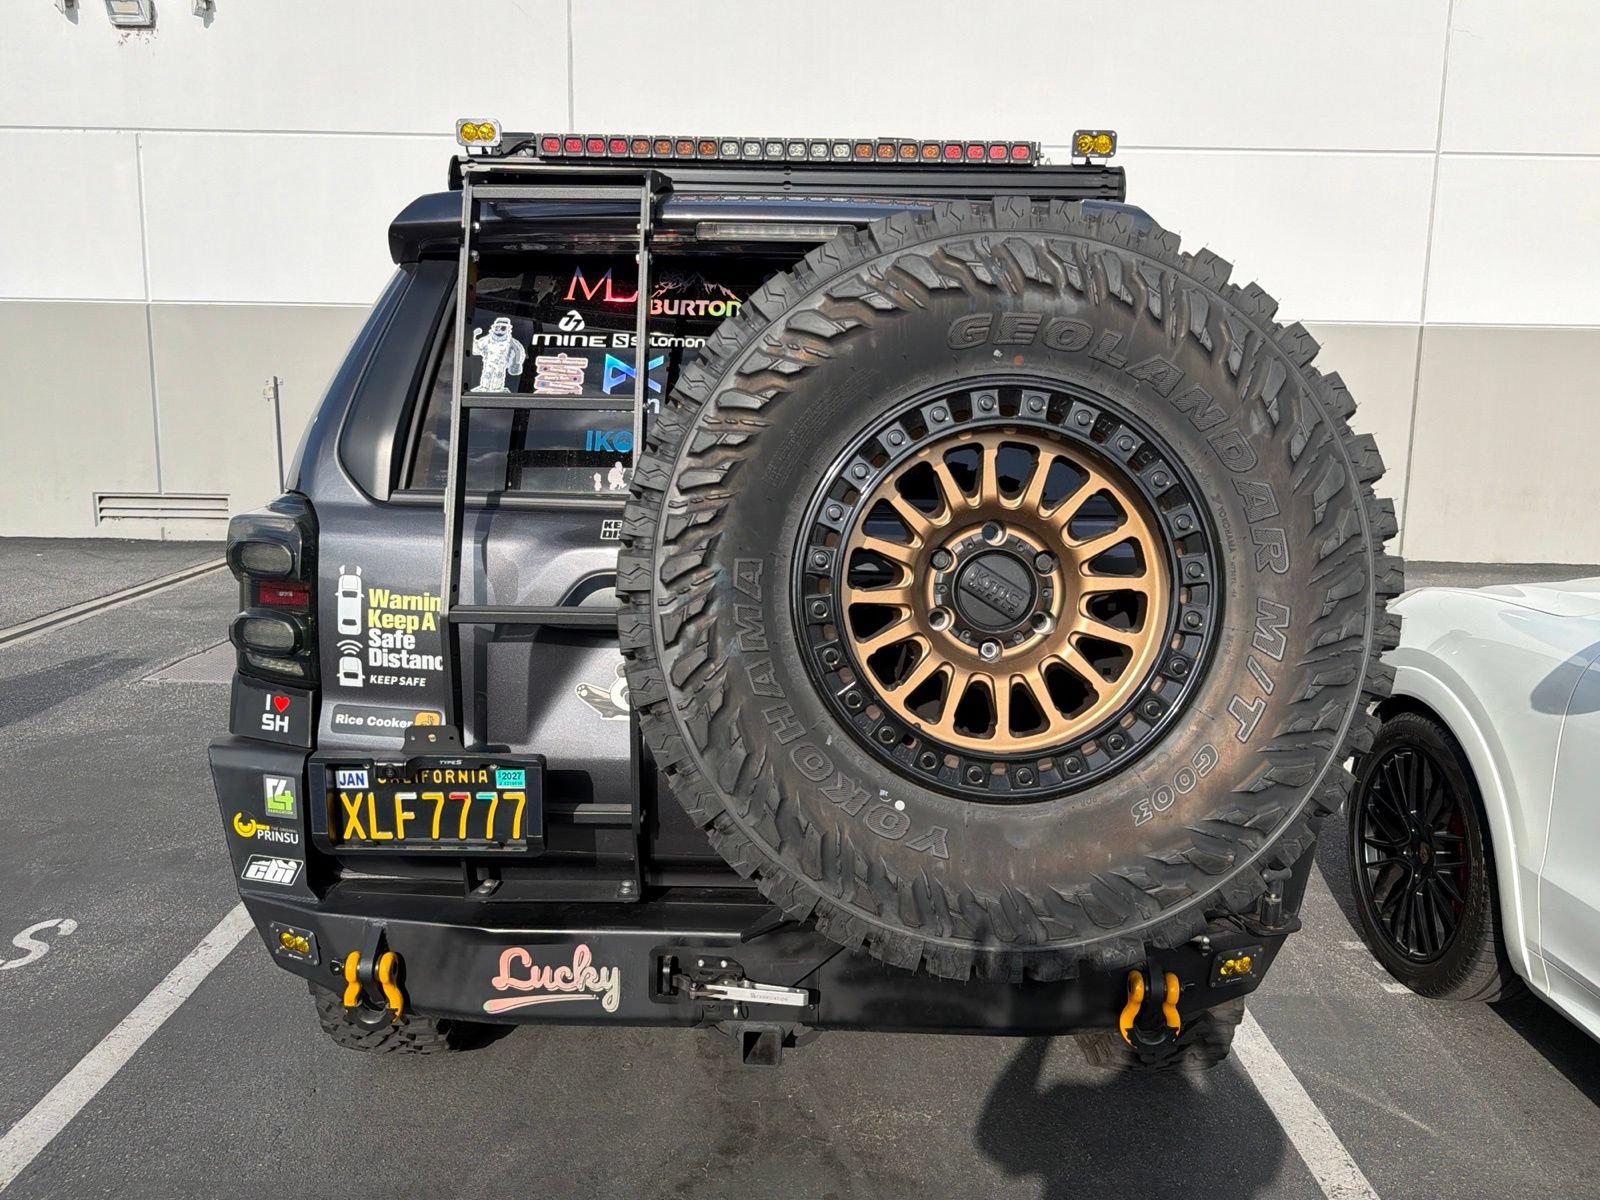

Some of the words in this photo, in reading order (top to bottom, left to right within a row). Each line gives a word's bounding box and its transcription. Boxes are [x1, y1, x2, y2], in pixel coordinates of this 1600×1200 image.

[650, 299, 742, 317] BURTON
[630, 335, 706, 348] SLOMON
[947, 311, 1291, 575] GEOLANDAR
[368, 588, 441, 611] Warnin
[368, 608, 419, 634] Keep
[421, 612, 436, 631] A
[368, 628, 416, 649] Safe
[368, 648, 444, 671] Distanc
[1228, 597, 1291, 743] M/T
[369, 675, 398, 685] KEEP
[399, 676, 426, 687] SAFE
[264, 693, 271, 711] I
[734, 558, 950, 860] YOKOHAMA
[261, 713, 290, 733] SH
[335, 713, 363, 726] Rice
[367, 715, 413, 729] Cooker
[340, 772, 365, 787] JAN
[502, 771, 521, 781] 2027
[1130, 743, 1219, 827] G003
[339, 792, 525, 840] XLF7777
[257, 829, 299, 845] PRINSU
[492, 944, 620, 1012] Lucky
